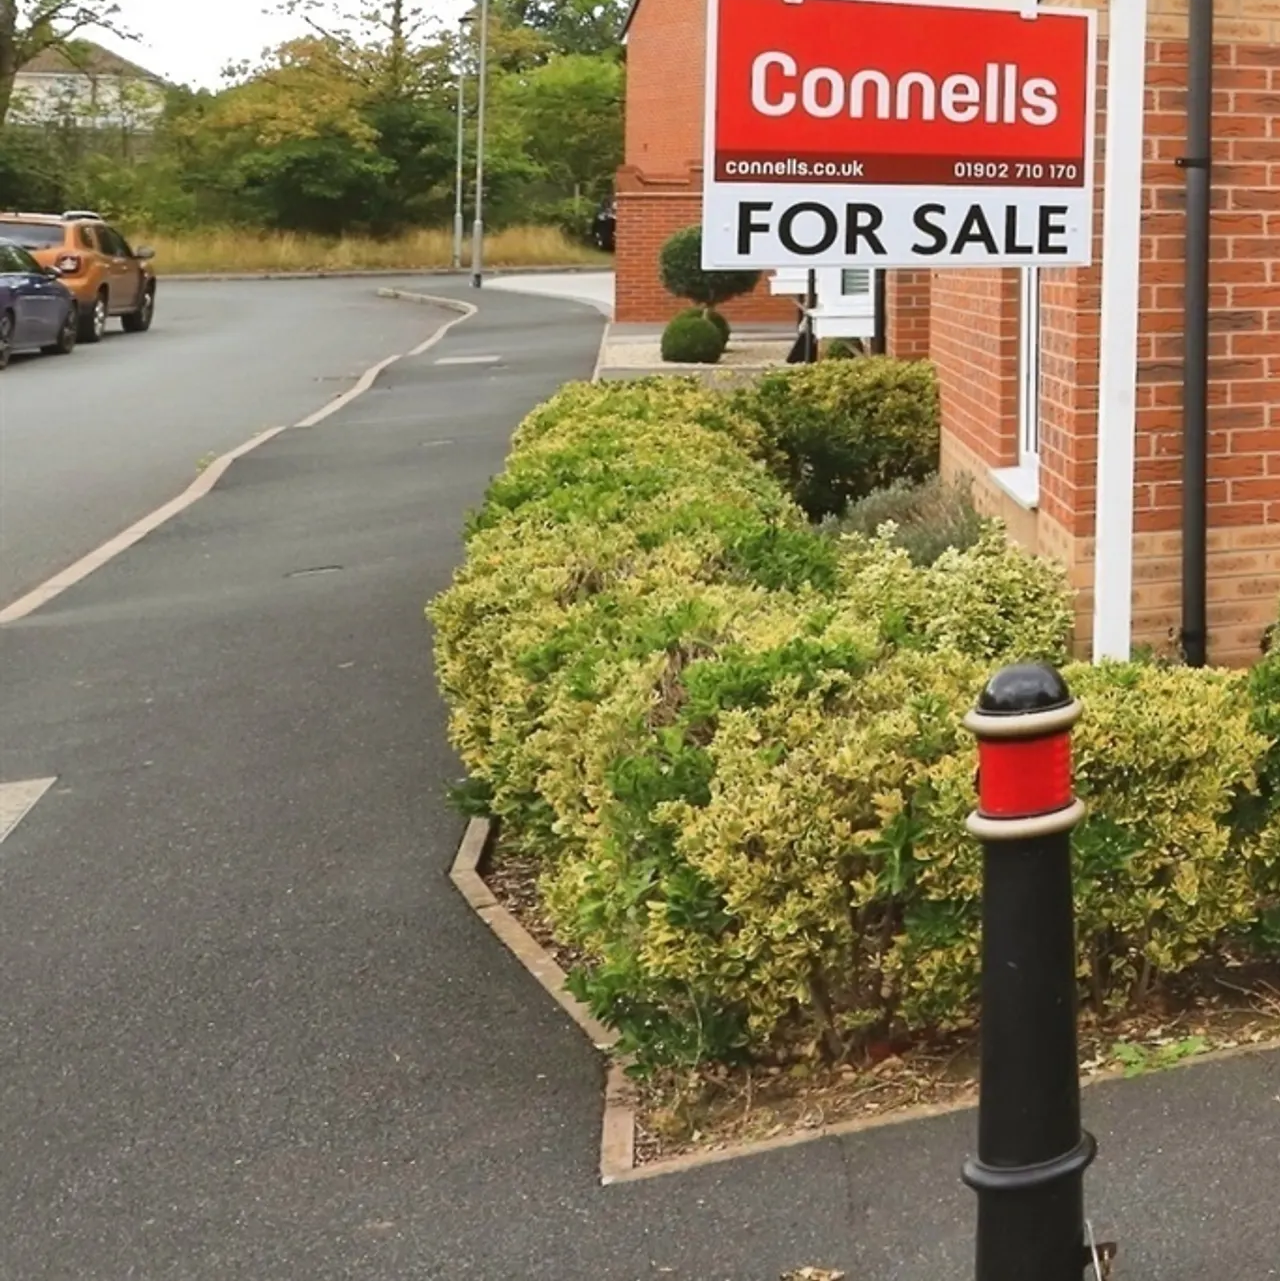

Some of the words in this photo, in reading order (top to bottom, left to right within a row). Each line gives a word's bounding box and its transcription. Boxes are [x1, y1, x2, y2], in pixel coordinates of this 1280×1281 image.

[750, 51, 1058, 126] Connells
[725, 158, 864, 177] connells.co.uk
[954, 162, 1009, 178] 01902
[1015, 163, 1043, 179] 710
[1049, 163, 1077, 180] 170
[736, 201, 888, 256] FOR
[911, 203, 1069, 256] SALE
